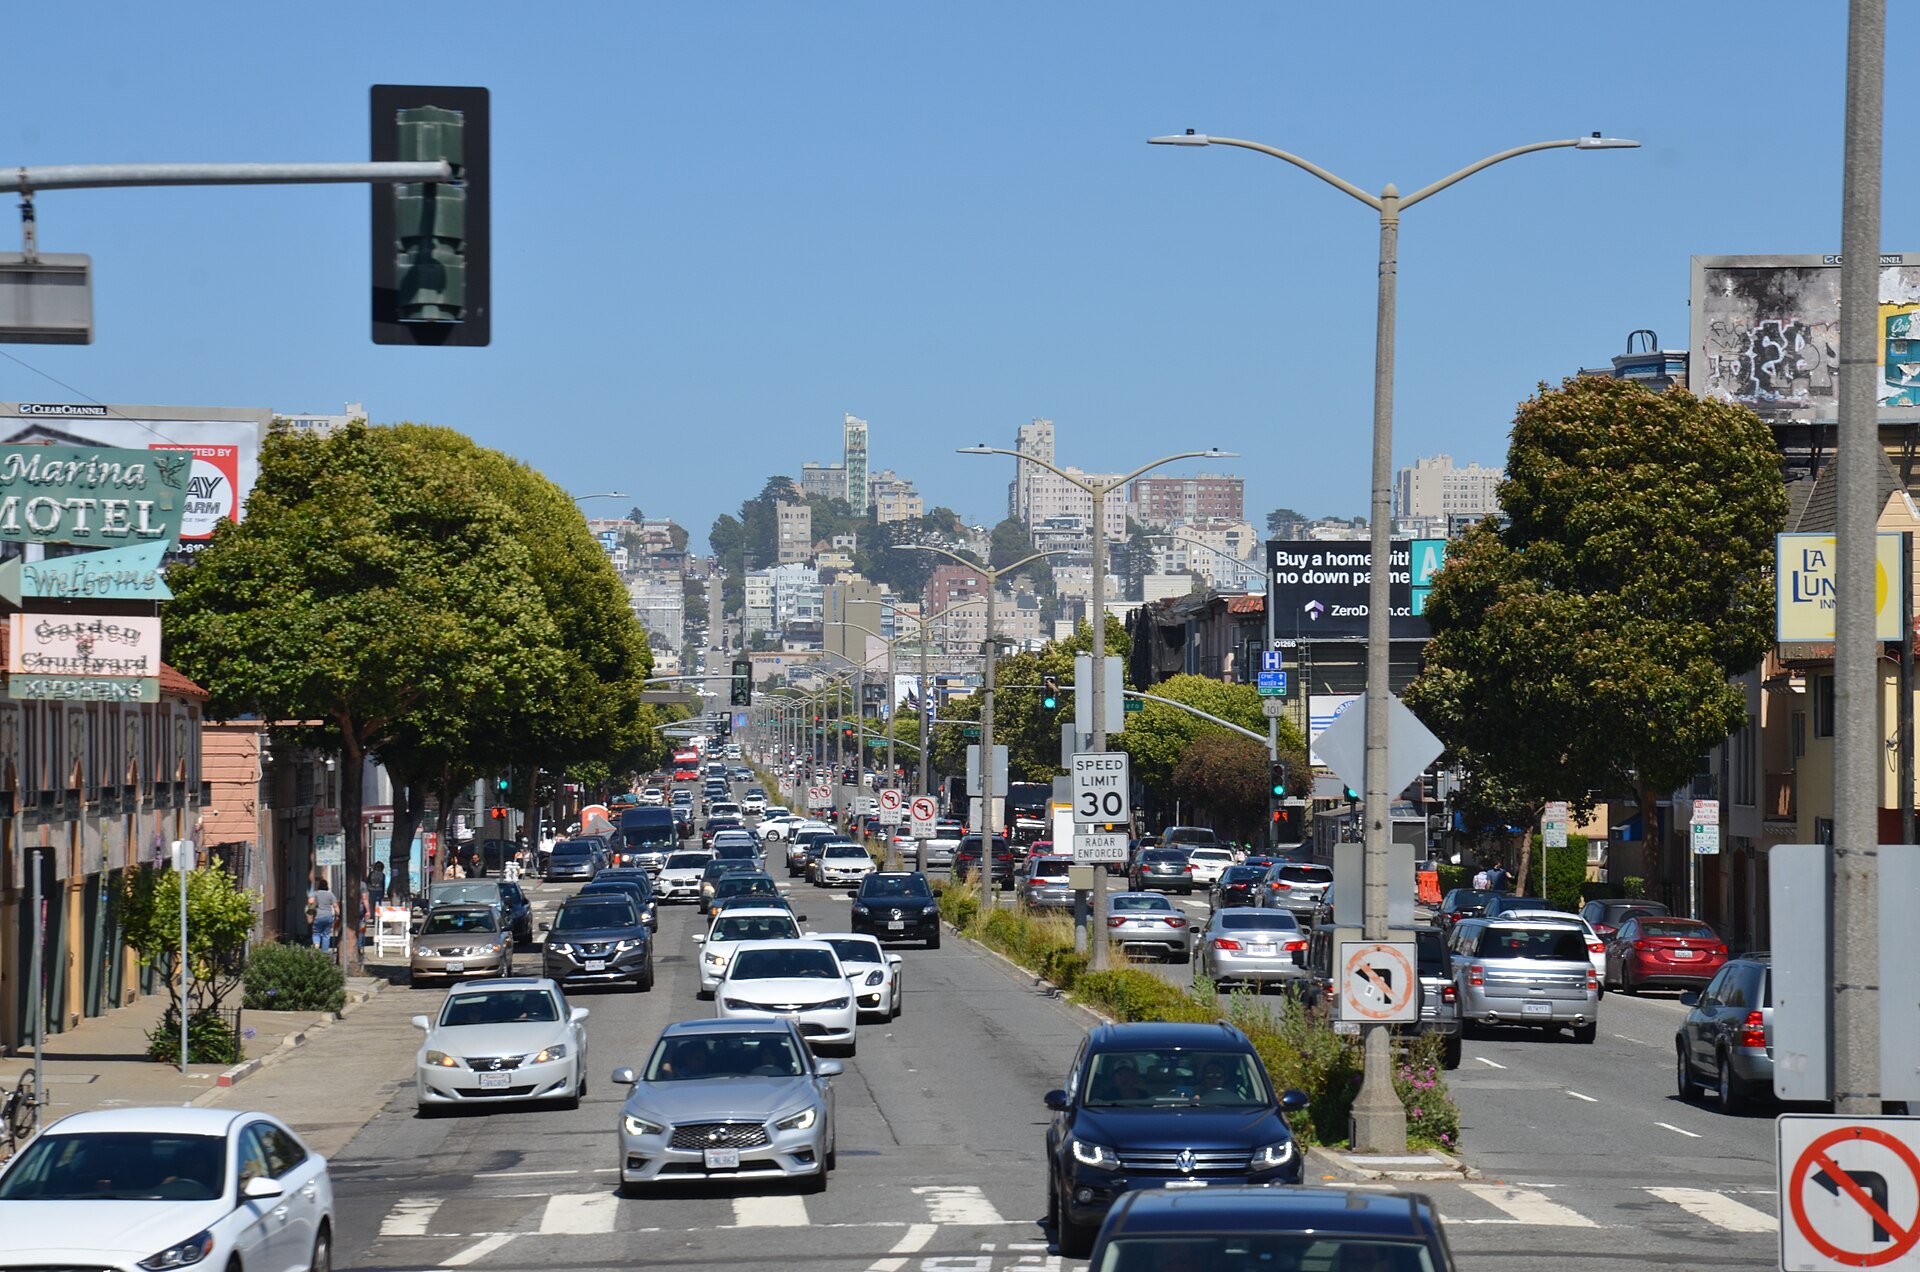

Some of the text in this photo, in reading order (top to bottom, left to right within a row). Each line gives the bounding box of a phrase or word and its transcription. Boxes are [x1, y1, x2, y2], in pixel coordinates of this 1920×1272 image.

[217, 448, 232, 457] BY
[0, 453, 147, 483] Marina
[187, 476, 224, 499] AY
[1276, 550, 1410, 568] Buy a home ith
[1803, 549, 1826, 572] LA
[24, 564, 157, 596] Welcome
[1276, 570, 1410, 586] no down pame
[1792, 571, 1836, 602] LUN
[34, 619, 141, 645] Garden
[21, 652, 148, 674] Courtyard
[1266, 654, 1280, 669] H
[26, 680, 143, 697] KITCHENS
[1267, 705, 1280, 715] 101
[1076, 760, 1124, 771] SPEED
[1081, 776, 1118, 786] LIMIT
[1080, 791, 1123, 817] 30
[1085, 838, 1116, 847] RADAR
[1078, 848, 1124, 859] ENFORCED
